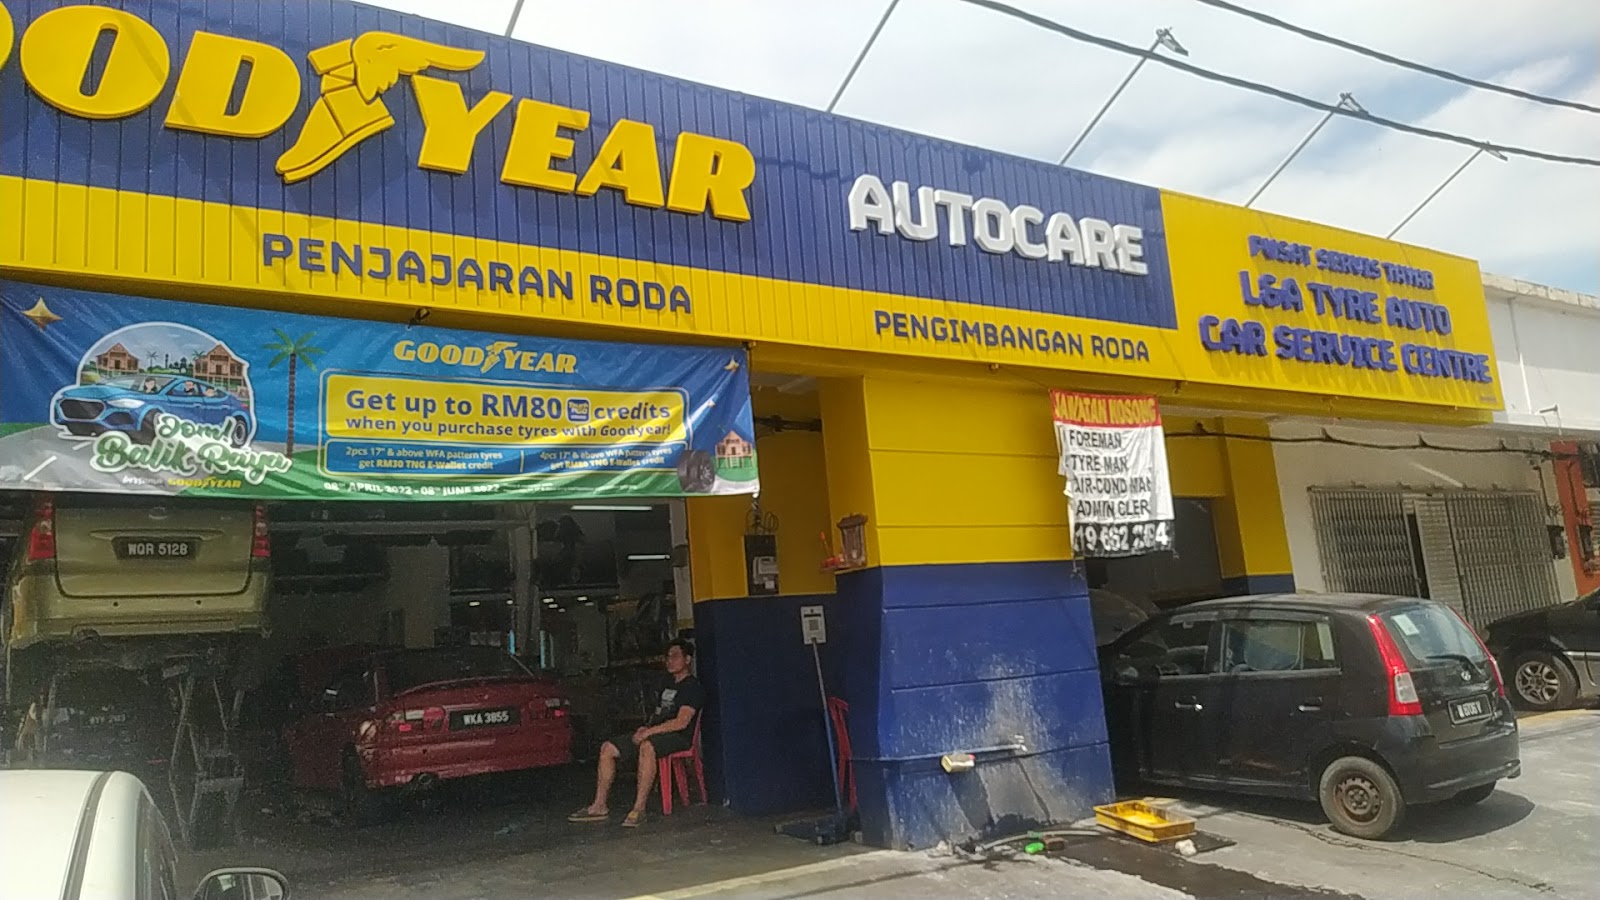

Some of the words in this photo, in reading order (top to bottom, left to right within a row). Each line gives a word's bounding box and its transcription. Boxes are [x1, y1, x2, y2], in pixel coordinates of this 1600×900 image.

[848, 174, 1148, 275] AUTOCARE
[263, 233, 573, 301] PENJAJARAN
[590, 279, 692, 314] RODA
[1248, 235, 1312, 267] PUSAT
[1315, 249, 1382, 280] SERVIS
[1306, 282, 1382, 324] TYRE
[1386, 296, 1452, 336] AUTO
[874, 310, 1083, 356] PENGIMBANGAN
[1091, 335, 1150, 362] RODA
[1199, 315, 1268, 356] CAR
[1273, 325, 1399, 372] SERVICE
[1401, 344, 1494, 384] CENTRE
[394, 340, 577, 374] GOODYEAR
[346, 390, 396, 411] Get
[405, 397, 437, 420] up
[445, 396, 472, 415] to
[481, 393, 562, 420] RM80
[594, 402, 670, 420] credits
[346, 416, 396, 431] when
[402, 421, 433, 434] you
[438, 422, 512, 437] purchase
[518, 424, 557, 439] tyres
[562, 424, 597, 437] with
[600, 424, 671, 438] Goodyear!
[1069, 430, 1122, 449] FOREMAN
[92, 433, 196, 475] Balik
[198, 442, 290, 484] Raya
[396, 448, 424, 458] above
[447, 450, 480, 460] pattern
[1070, 454, 1100, 471] TYRE
[1104, 456, 1129, 473] MAN
[1076, 500, 1117, 520] ADMIN
[128, 542, 154, 556] WQR
[158, 542, 188, 556] 5128
[463, 713, 483, 725] WKA
